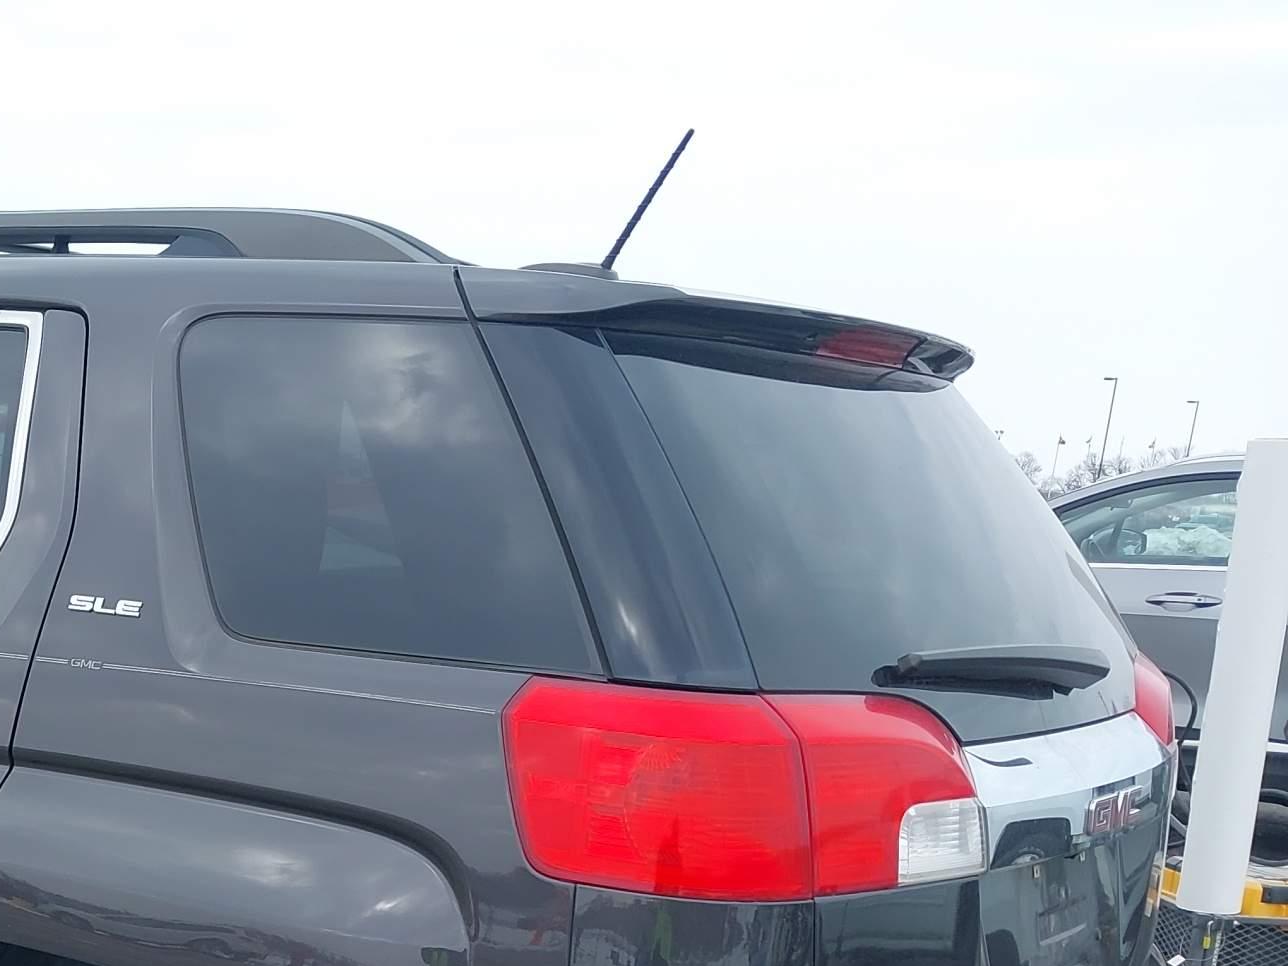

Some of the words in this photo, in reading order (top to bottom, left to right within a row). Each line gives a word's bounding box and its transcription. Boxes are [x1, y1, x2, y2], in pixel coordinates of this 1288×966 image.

[67, 594, 143, 618] SLE
[70, 658, 102, 670] GMC
[1086, 785, 1150, 833] GMC
